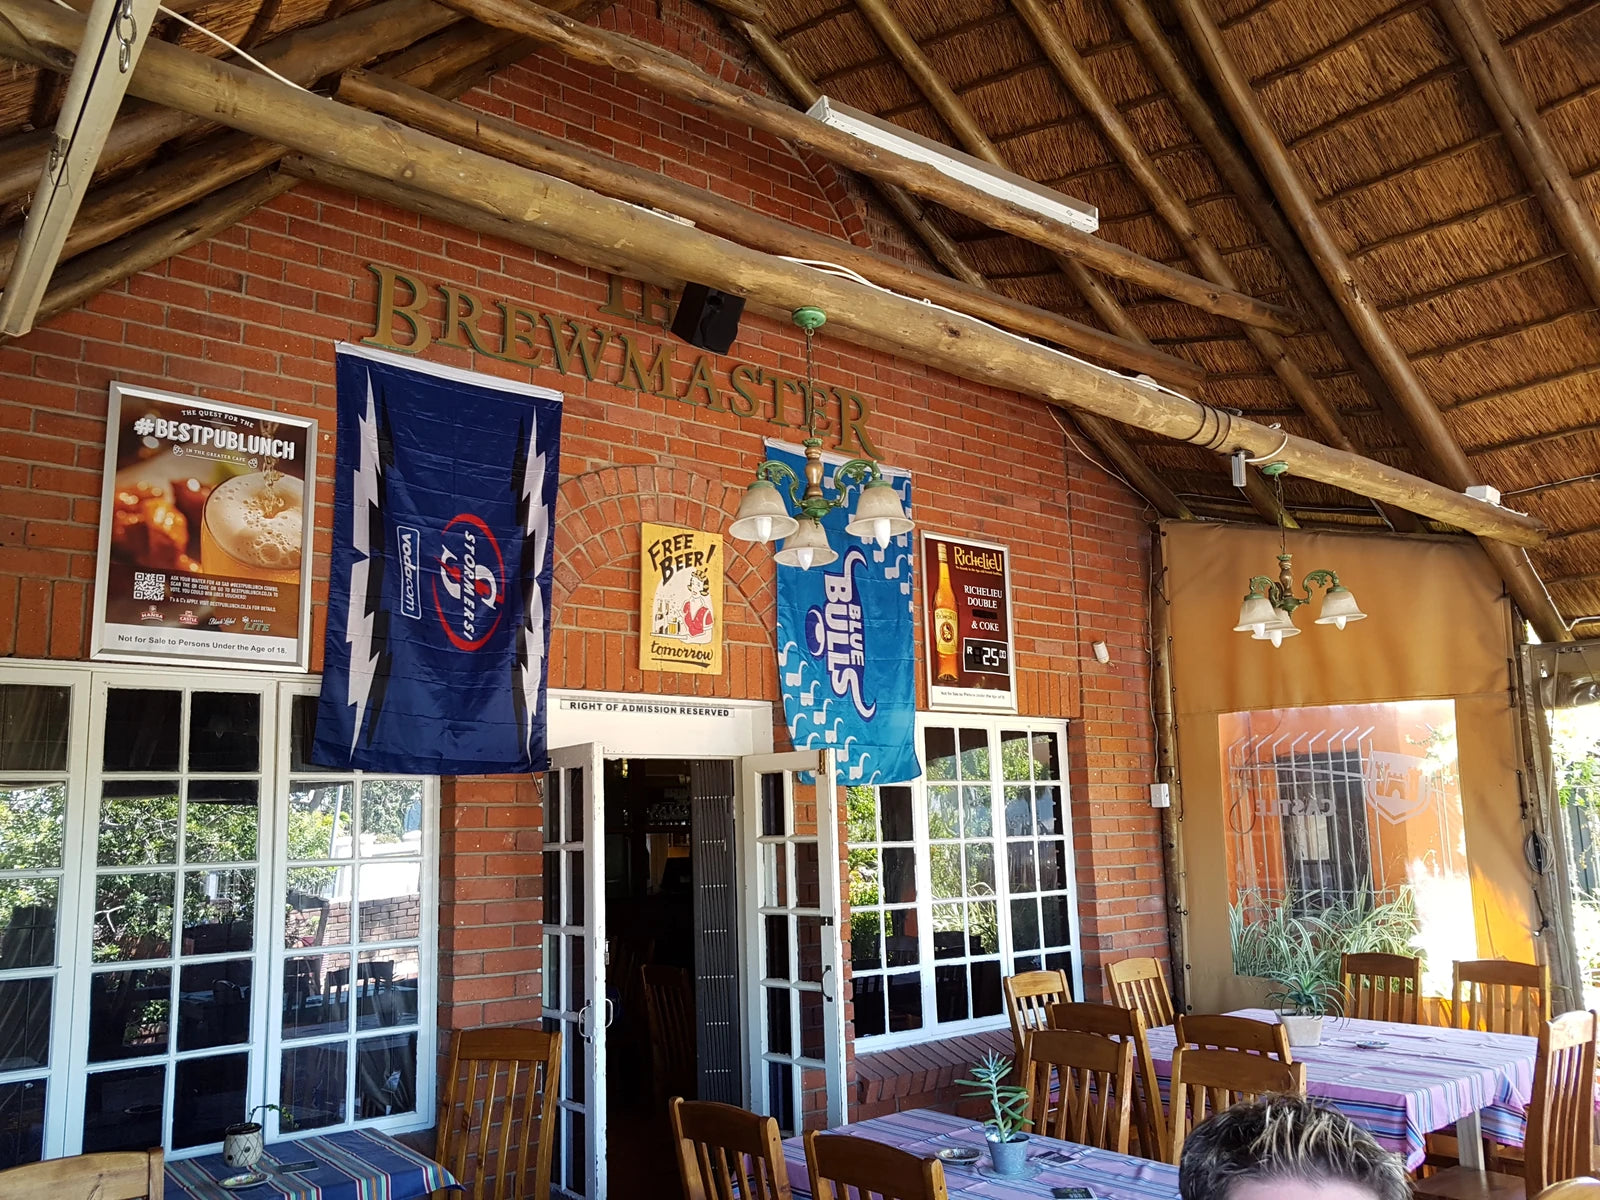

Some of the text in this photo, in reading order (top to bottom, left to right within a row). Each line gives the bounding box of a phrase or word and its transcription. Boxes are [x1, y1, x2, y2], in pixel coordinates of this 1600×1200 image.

[359, 263, 884, 460] BREWMASTER
[198, 410, 222, 418] QUEST
[224, 414, 238, 422] FOR
[240, 418, 255, 428] THE
[134, 417, 296, 460] #BESTPUBLUNCH
[648, 534, 694, 572] FREE
[401, 533, 416, 612] vodacom
[659, 544, 717, 586] BEER!
[964, 585, 1003, 598] RICHELIEU
[968, 597, 998, 609] DOUBLE
[244, 622, 271, 632] LITE
[824, 550, 877, 719] BULLS
[849, 604, 865, 667] BLUE
[971, 620, 1000, 632] & COKE
[134, 636, 146, 644] for
[148, 636, 166, 645] Sale
[168, 638, 176, 646] to
[178, 639, 210, 648] Persons
[212, 642, 236, 650] Under
[237, 643, 249, 651] the
[251, 645, 265, 653] Age
[650, 640, 713, 661] tomorrow
[966, 646, 973, 655] R
[982, 647, 999, 666] 25
[570, 702, 730, 717] RIGHT OF ADMISSION RESERVED
